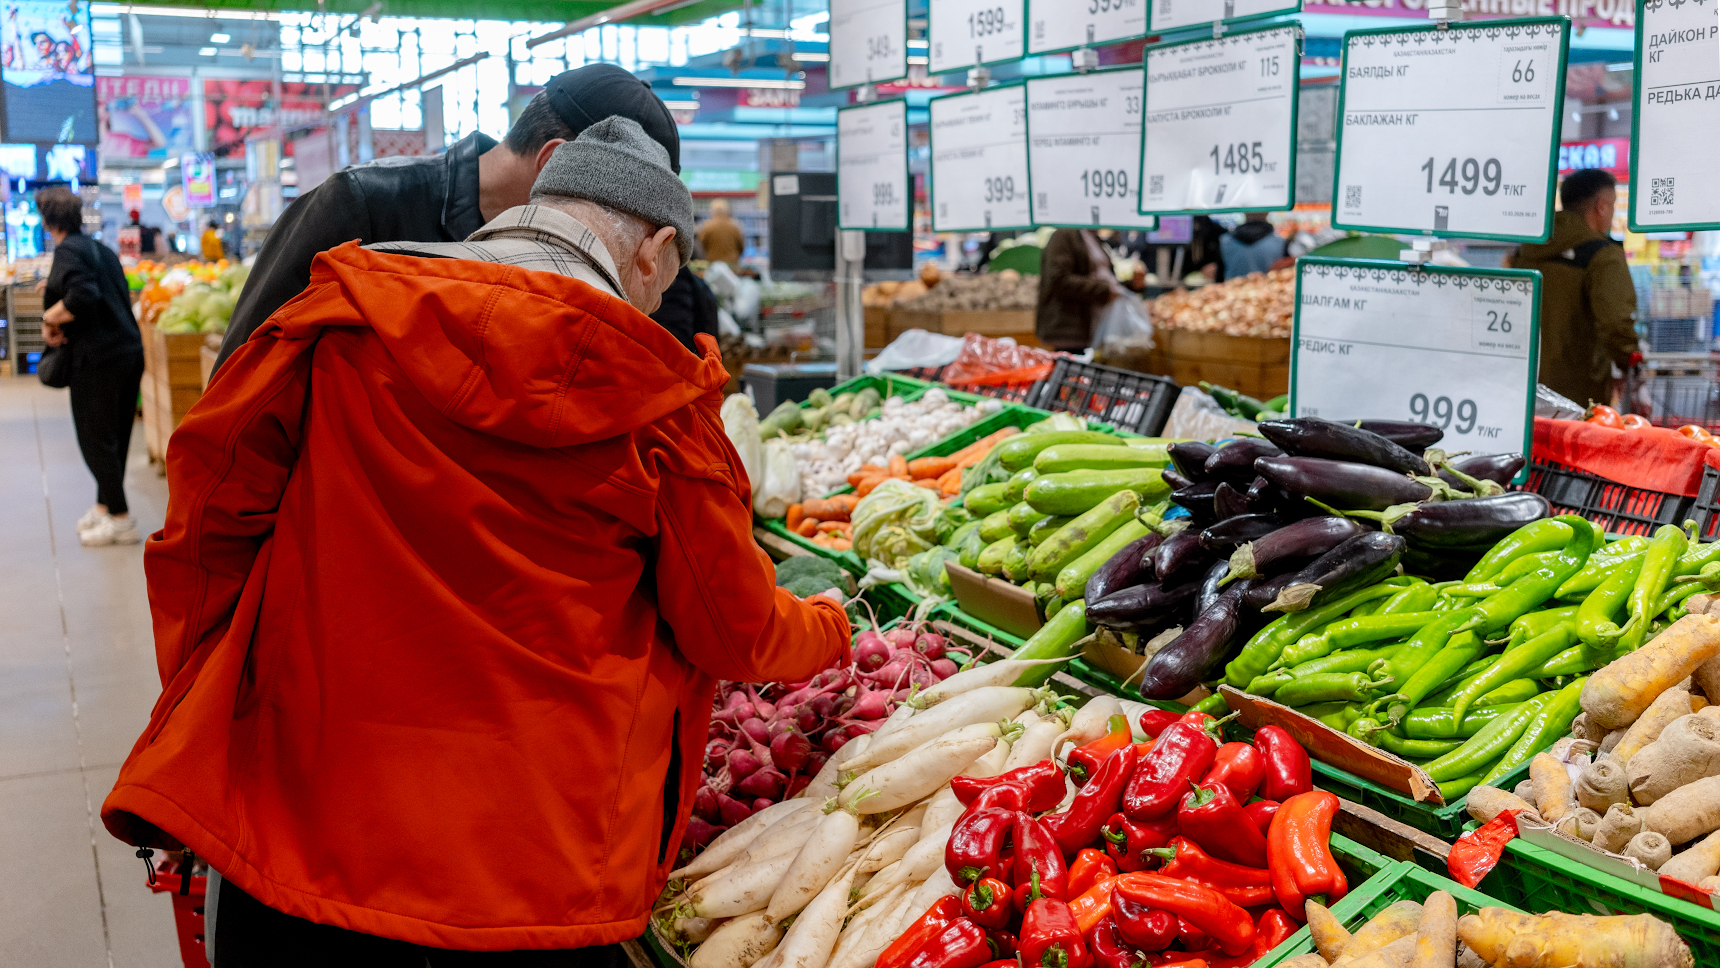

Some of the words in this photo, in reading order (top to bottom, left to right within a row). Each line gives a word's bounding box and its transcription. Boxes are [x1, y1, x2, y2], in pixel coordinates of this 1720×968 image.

[967, 7, 1005, 39] 1599
[1649, 27, 1705, 49] ДАЙКОН
[1238, 60, 1247, 71] КГ
[1260, 56, 1279, 77] 115
[1649, 50, 1664, 63] КГ
[1349, 65, 1394, 79] БАЯЛДЫ
[1397, 65, 1409, 77] КГ
[1512, 59, 1535, 83] 66
[1125, 96, 1139, 114] 33
[1648, 87, 1702, 105] РЕДЬКА
[1346, 114, 1402, 126] БАКЛАЖАН
[1405, 114, 1419, 125] КГ
[1210, 141, 1263, 175] 1485
[1080, 170, 1128, 198] 1999
[1421, 157, 1502, 196] 1499
[984, 176, 1014, 203] 399
[1301, 294, 1350, 309] ШАЛҒАМ
[1354, 299, 1367, 311] КГ
[1487, 310, 1512, 333] 26
[1299, 339, 1335, 353] РЕДИС
[1339, 344, 1353, 355] КГ
[1409, 393, 1478, 435] 999
